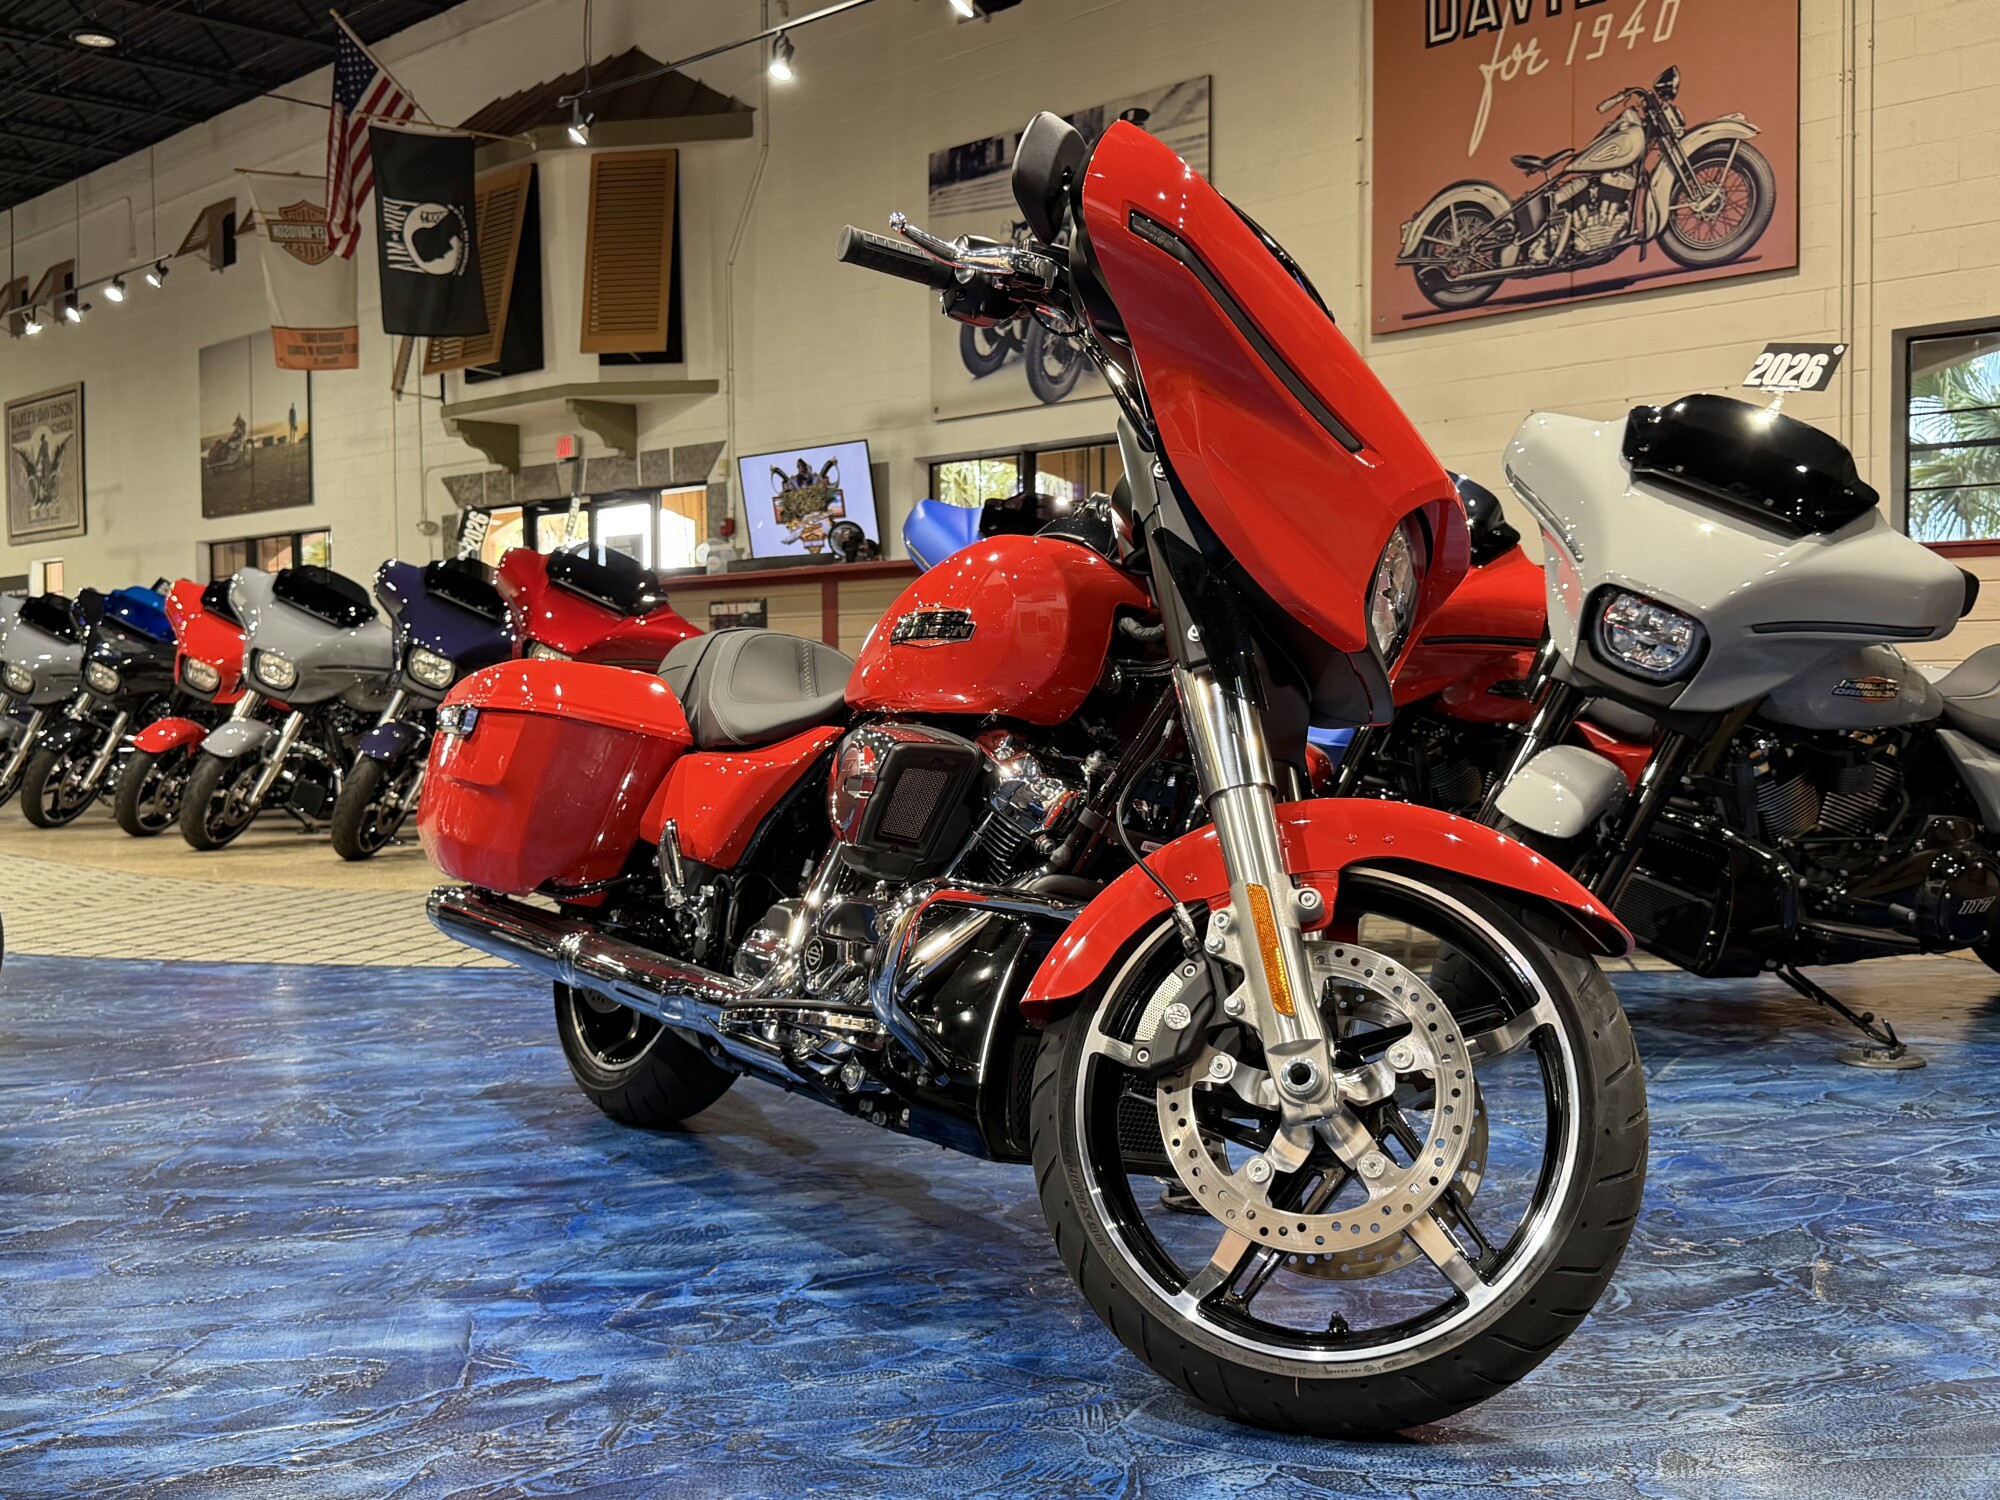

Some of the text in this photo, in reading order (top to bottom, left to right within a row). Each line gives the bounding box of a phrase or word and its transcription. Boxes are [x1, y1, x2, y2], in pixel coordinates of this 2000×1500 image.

[1468, 0, 1682, 157] for 1940
[1742, 352, 1829, 389] 2026
[463, 510, 490, 550] 2026
